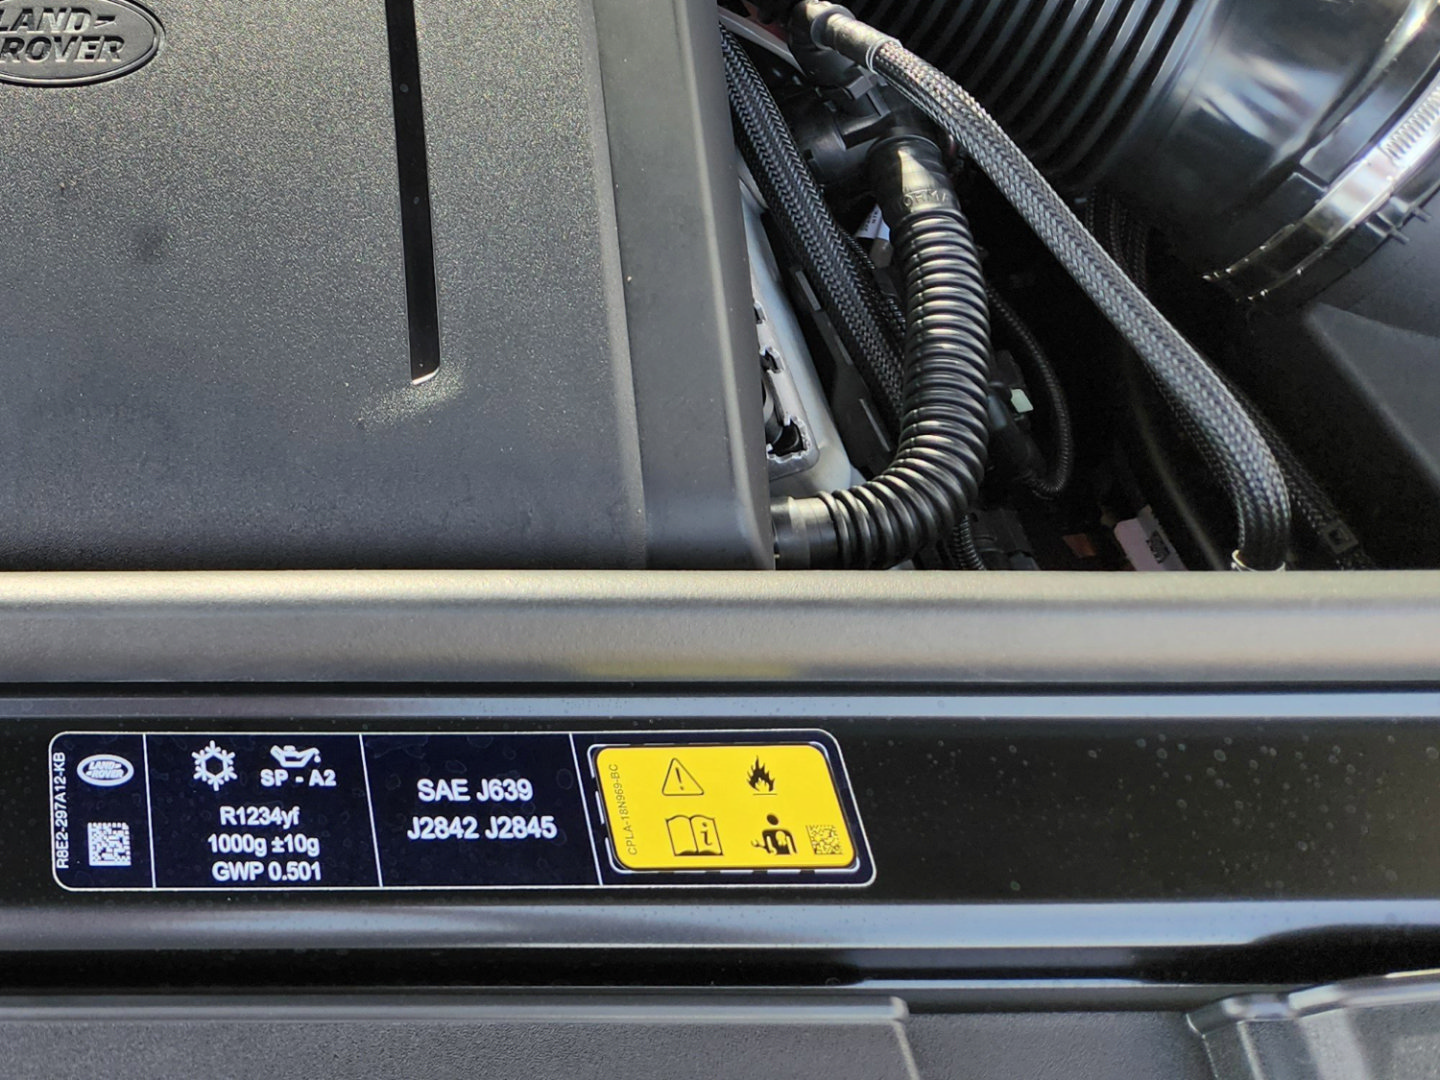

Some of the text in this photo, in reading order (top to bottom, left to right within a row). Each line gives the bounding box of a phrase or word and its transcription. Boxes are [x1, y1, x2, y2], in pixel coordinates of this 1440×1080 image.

[88, 761, 115, 770] LAND
[92, 769, 125, 779] ROVER
[260, 768, 289, 787] SP
[308, 768, 337, 787] A2
[417, 778, 534, 802] SAE J639
[52, 751, 70, 869] R8E2-297A12-KB
[219, 806, 300, 830] R1234yf
[608, 763, 637, 856] CPLA-18N969-BC
[407, 816, 558, 839] J2842 J2845
[207, 833, 320, 857] 1000g ±10g
[212, 861, 321, 881] GWP 0.501
